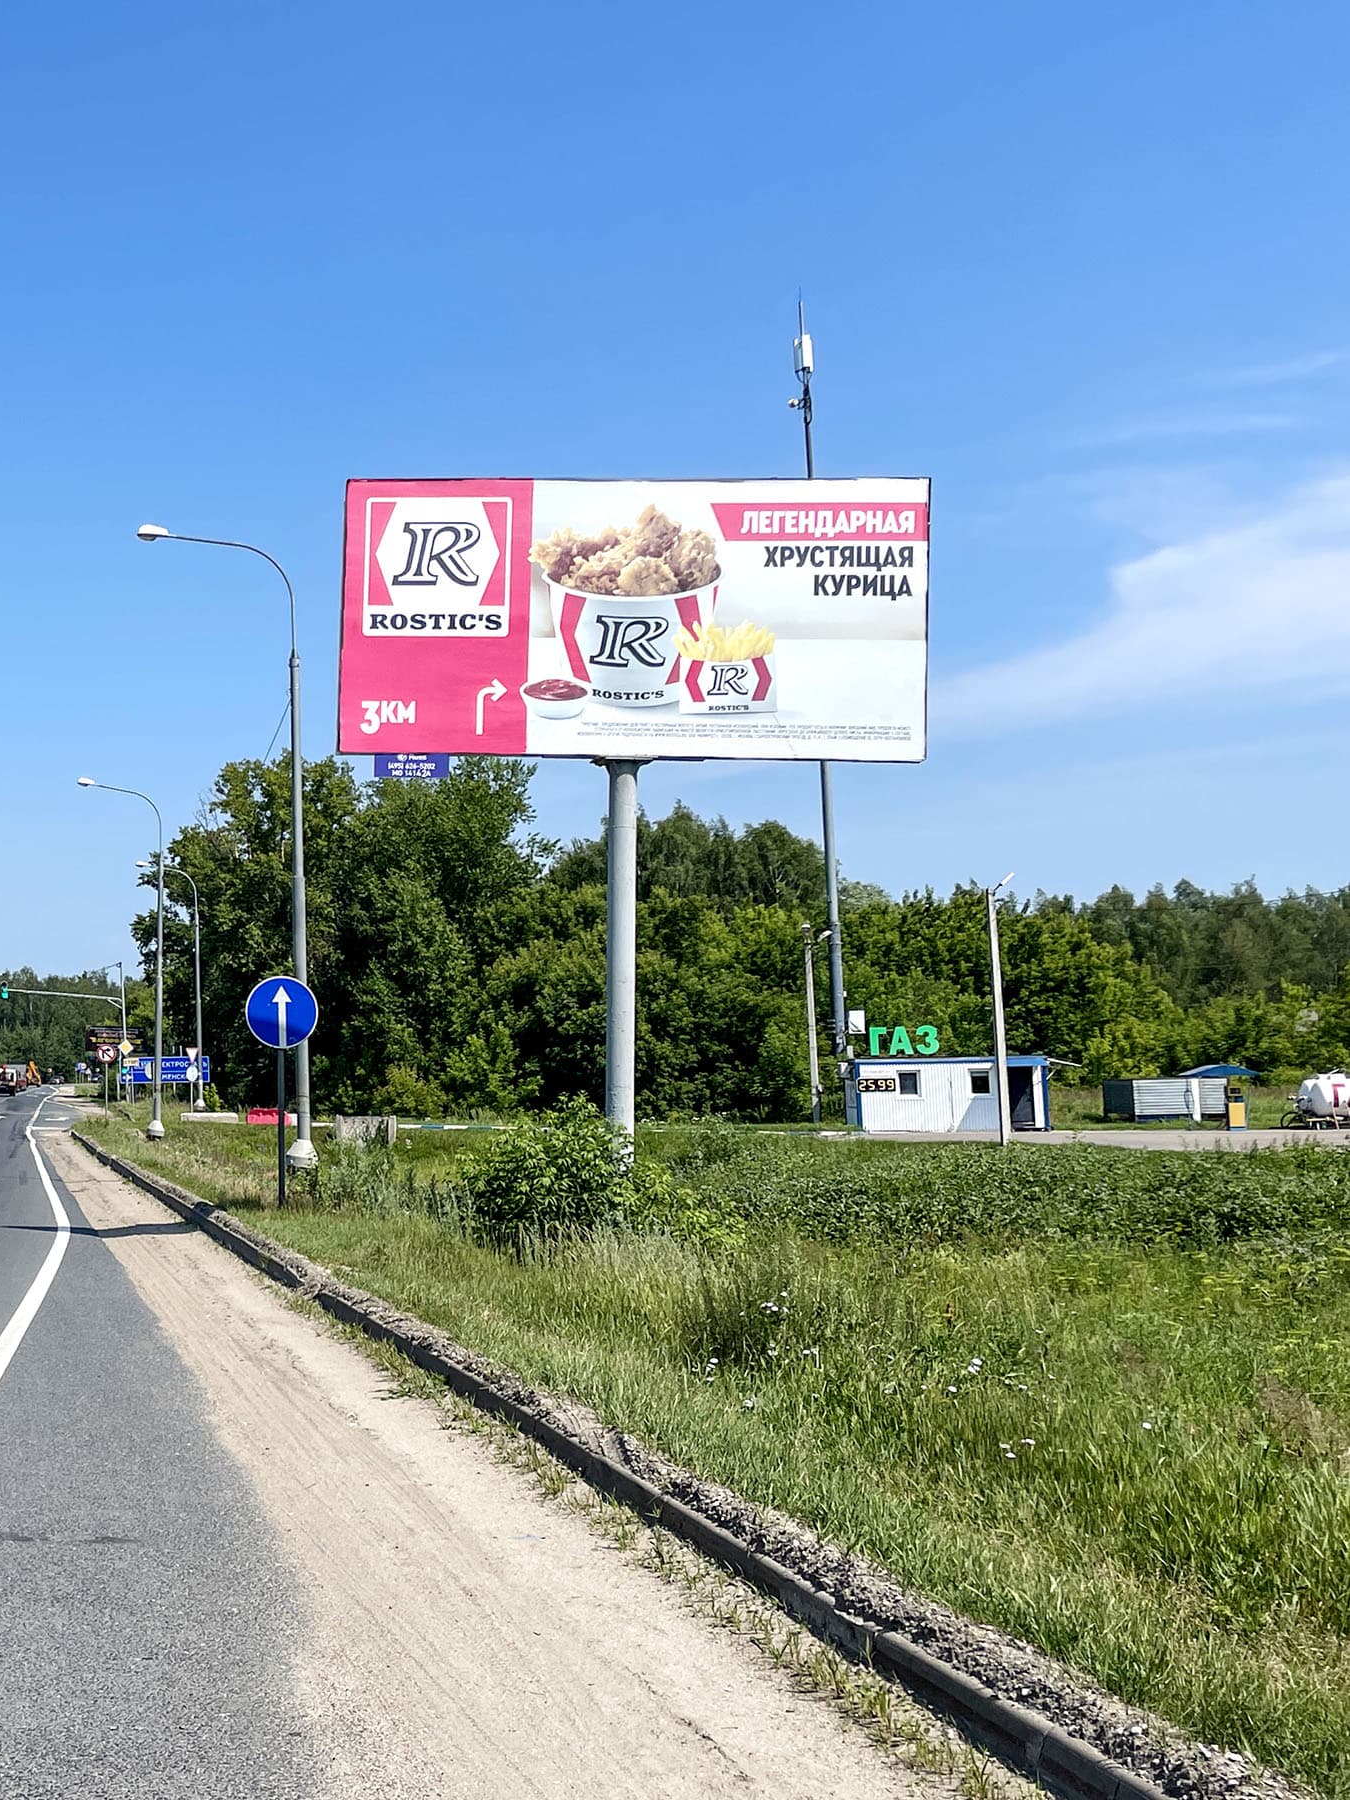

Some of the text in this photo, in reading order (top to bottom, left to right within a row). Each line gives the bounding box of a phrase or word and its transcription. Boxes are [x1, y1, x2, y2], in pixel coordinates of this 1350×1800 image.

[741, 511, 915, 537] ЛЕГЕНДАРНАЯ
[764, 546, 914, 571] ХРУСТЯЩАЯ
[814, 575, 913, 600] КУРИЦА
[369, 614, 502, 630] ROSTIC'S
[592, 689, 664, 700] ROSTIC'S
[869, 1025, 939, 1056] ГАЗ
